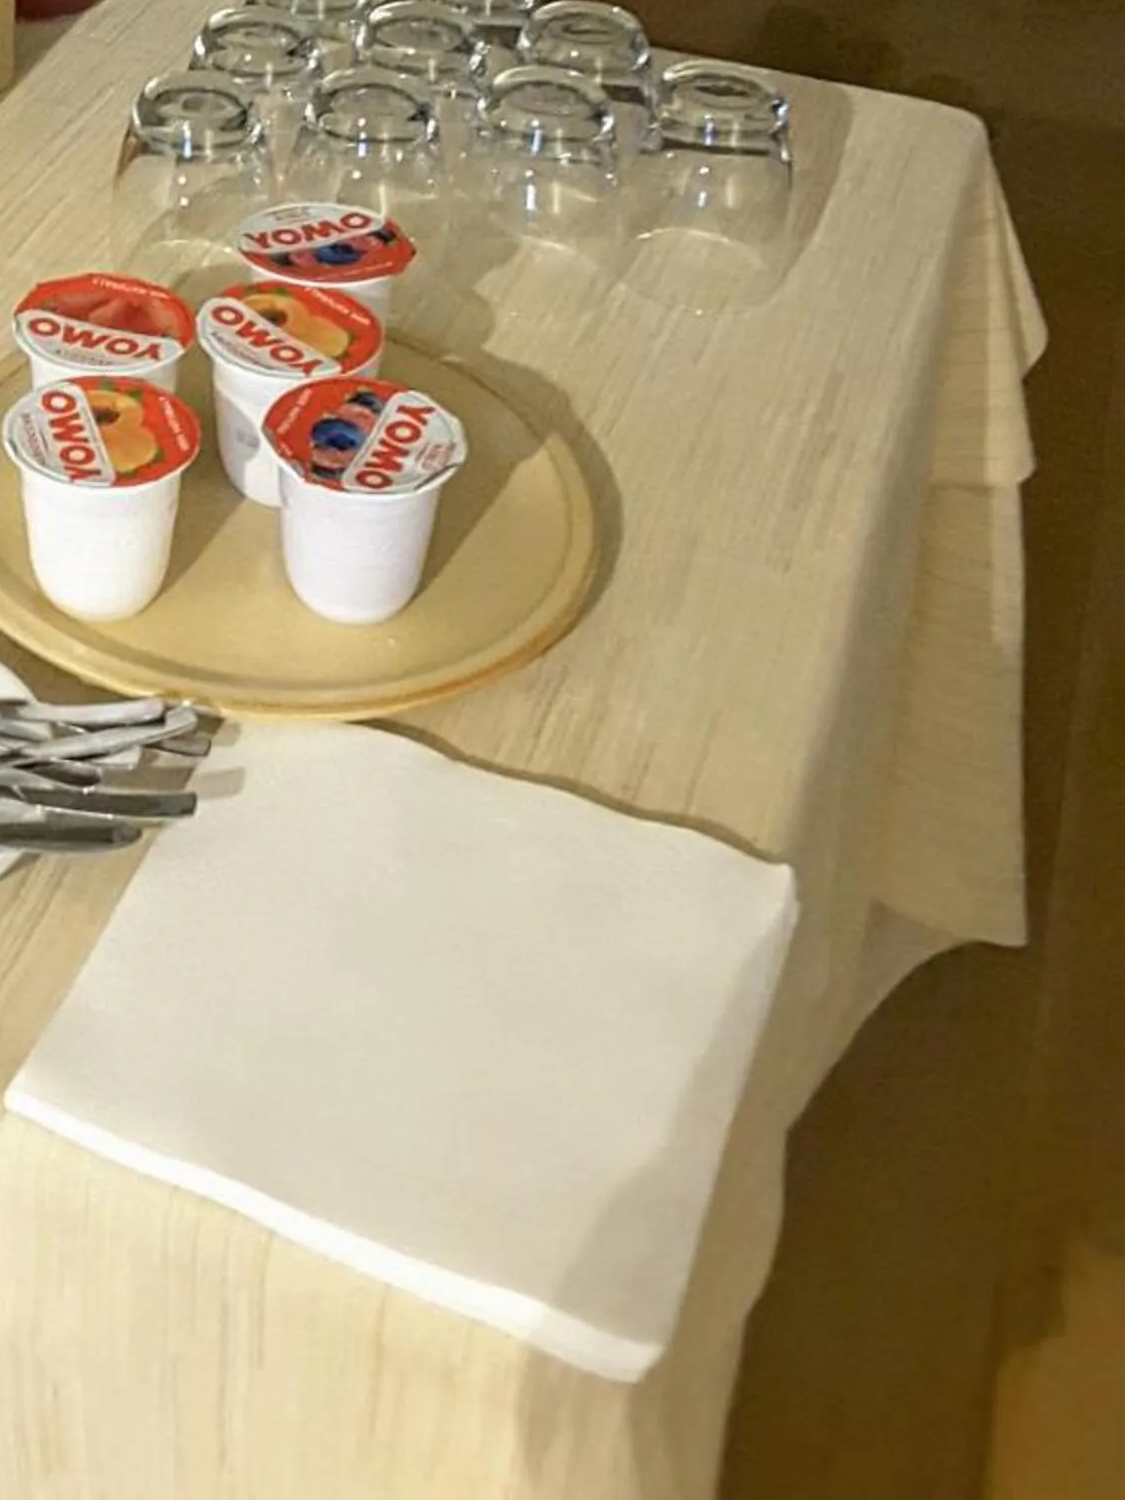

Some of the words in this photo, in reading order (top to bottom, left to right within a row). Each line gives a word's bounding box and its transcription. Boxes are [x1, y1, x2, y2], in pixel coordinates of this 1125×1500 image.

[242, 211, 372, 250] YOMO
[27, 316, 165, 362] YOMO
[210, 303, 324, 377] YOMO
[40, 390, 103, 483] YOMO
[355, 403, 437, 491] YOMO
